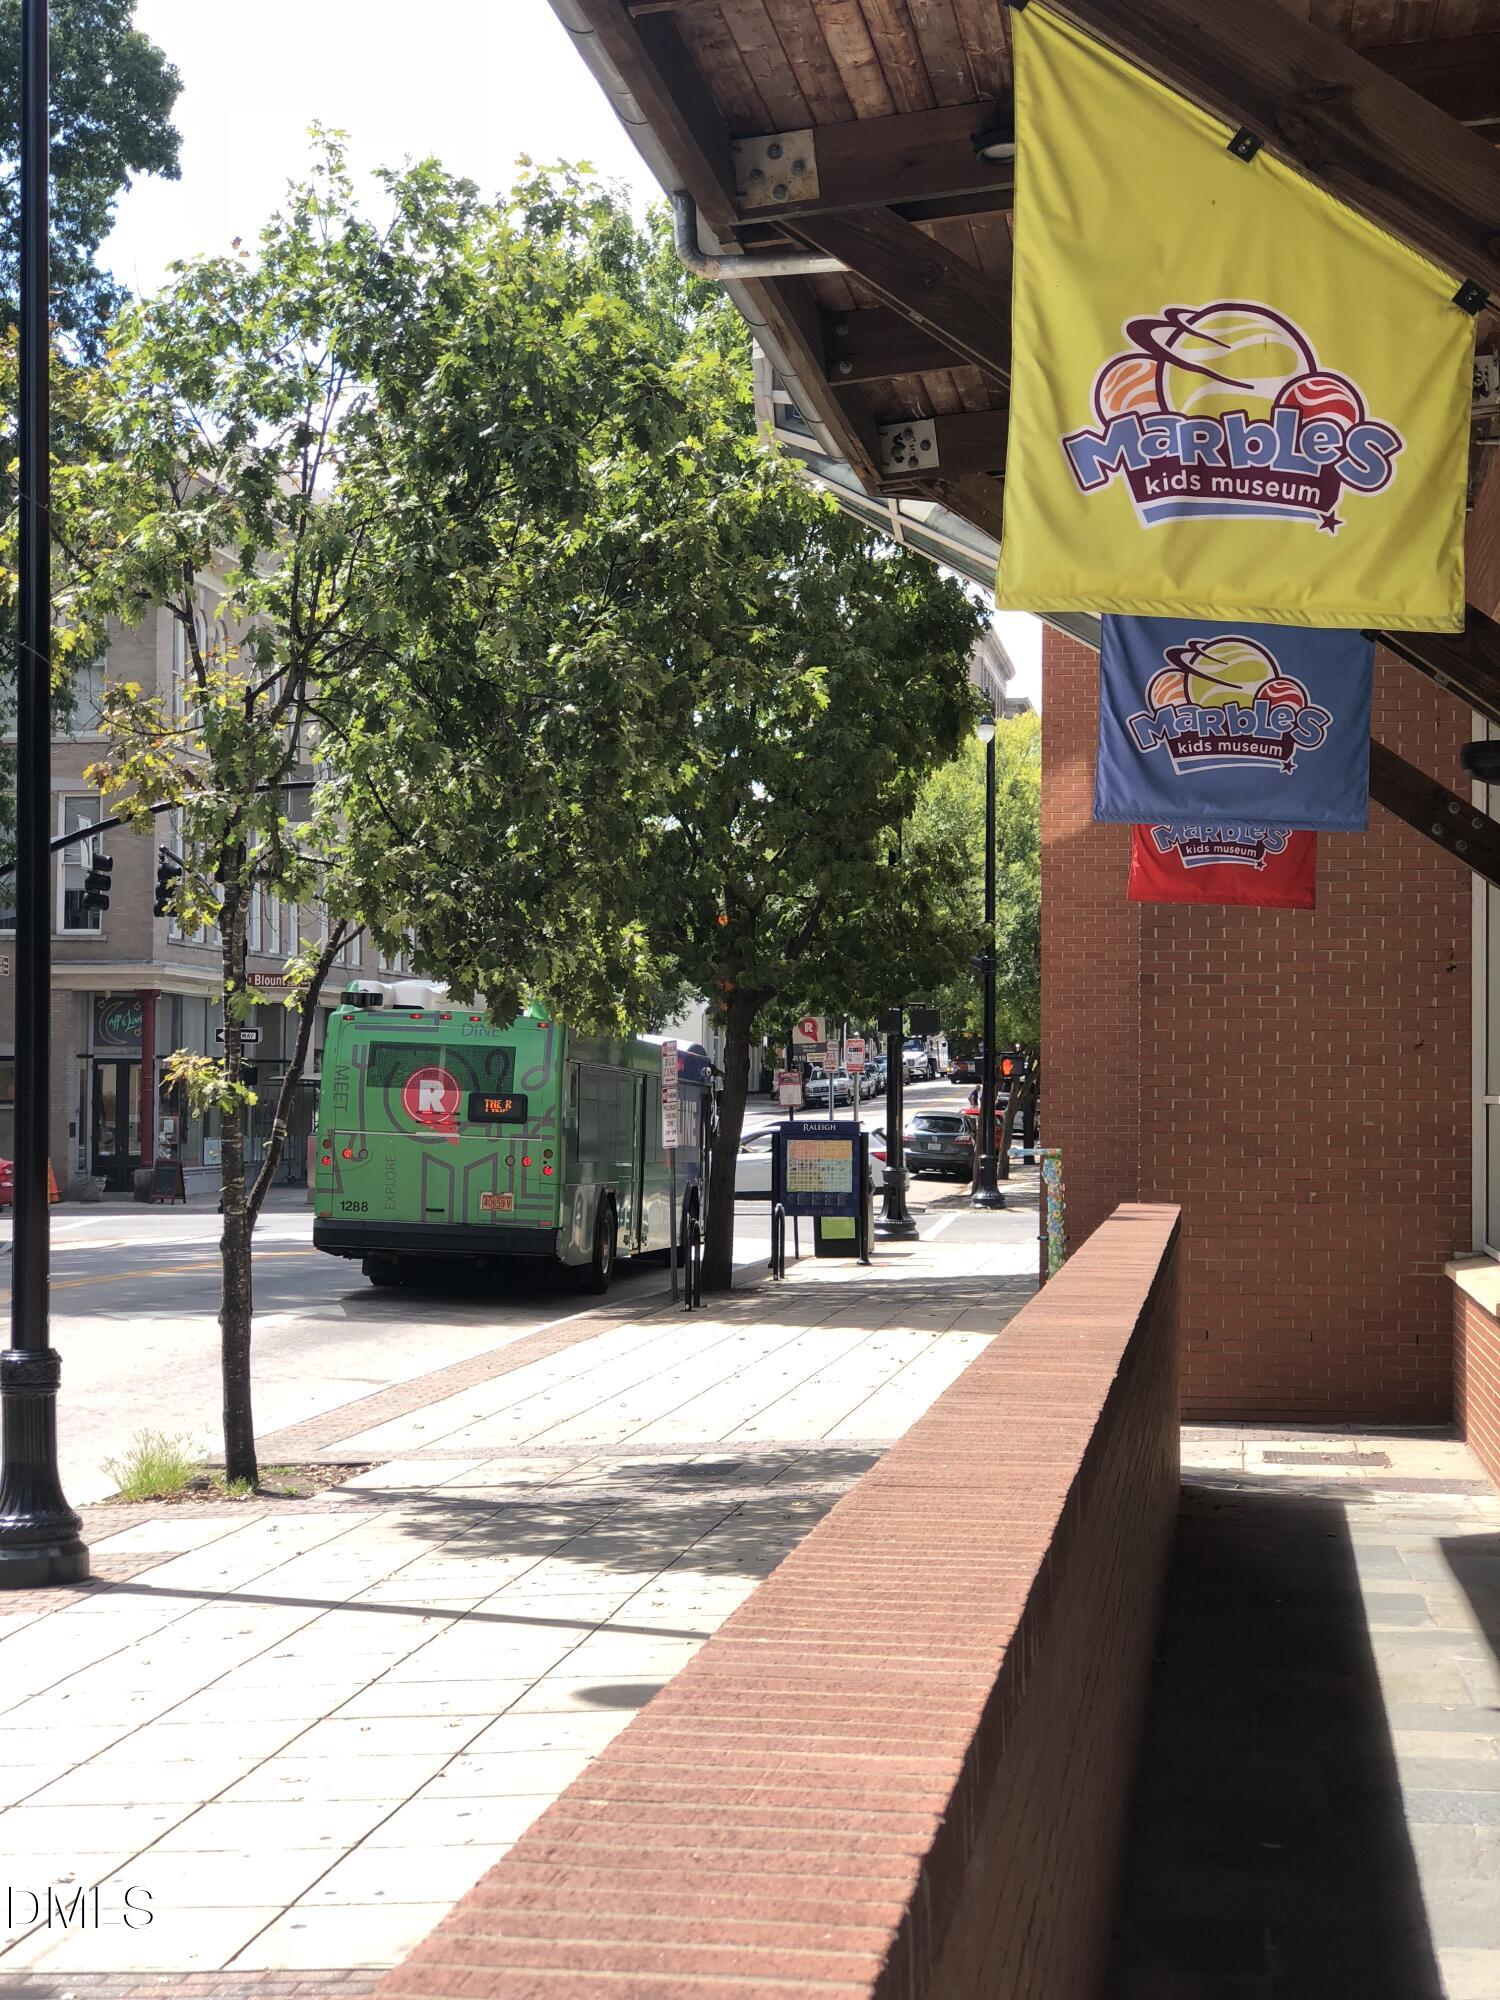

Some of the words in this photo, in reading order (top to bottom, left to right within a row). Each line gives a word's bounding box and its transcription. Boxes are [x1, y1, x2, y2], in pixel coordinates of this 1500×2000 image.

[1145, 469, 1201, 496] kids
[1210, 477, 1321, 504] museum
[1177, 739, 1212, 754] kids
[1218, 741, 1283, 757] museum
[1185, 844, 1210, 855] kids
[1213, 845, 1257, 858] museum
[254, 974, 286, 986] Blount
[461, 1024, 500, 1038] DINE
[804, 1022, 814, 1033] R
[241, 1032, 255, 1040] WAY
[333, 1065, 349, 1113] MEET
[418, 1079, 446, 1113] R
[803, 1123, 836, 1132] RALEIGH
[384, 1154, 396, 1210] EXPLORE
[339, 1200, 369, 1212] 1288
